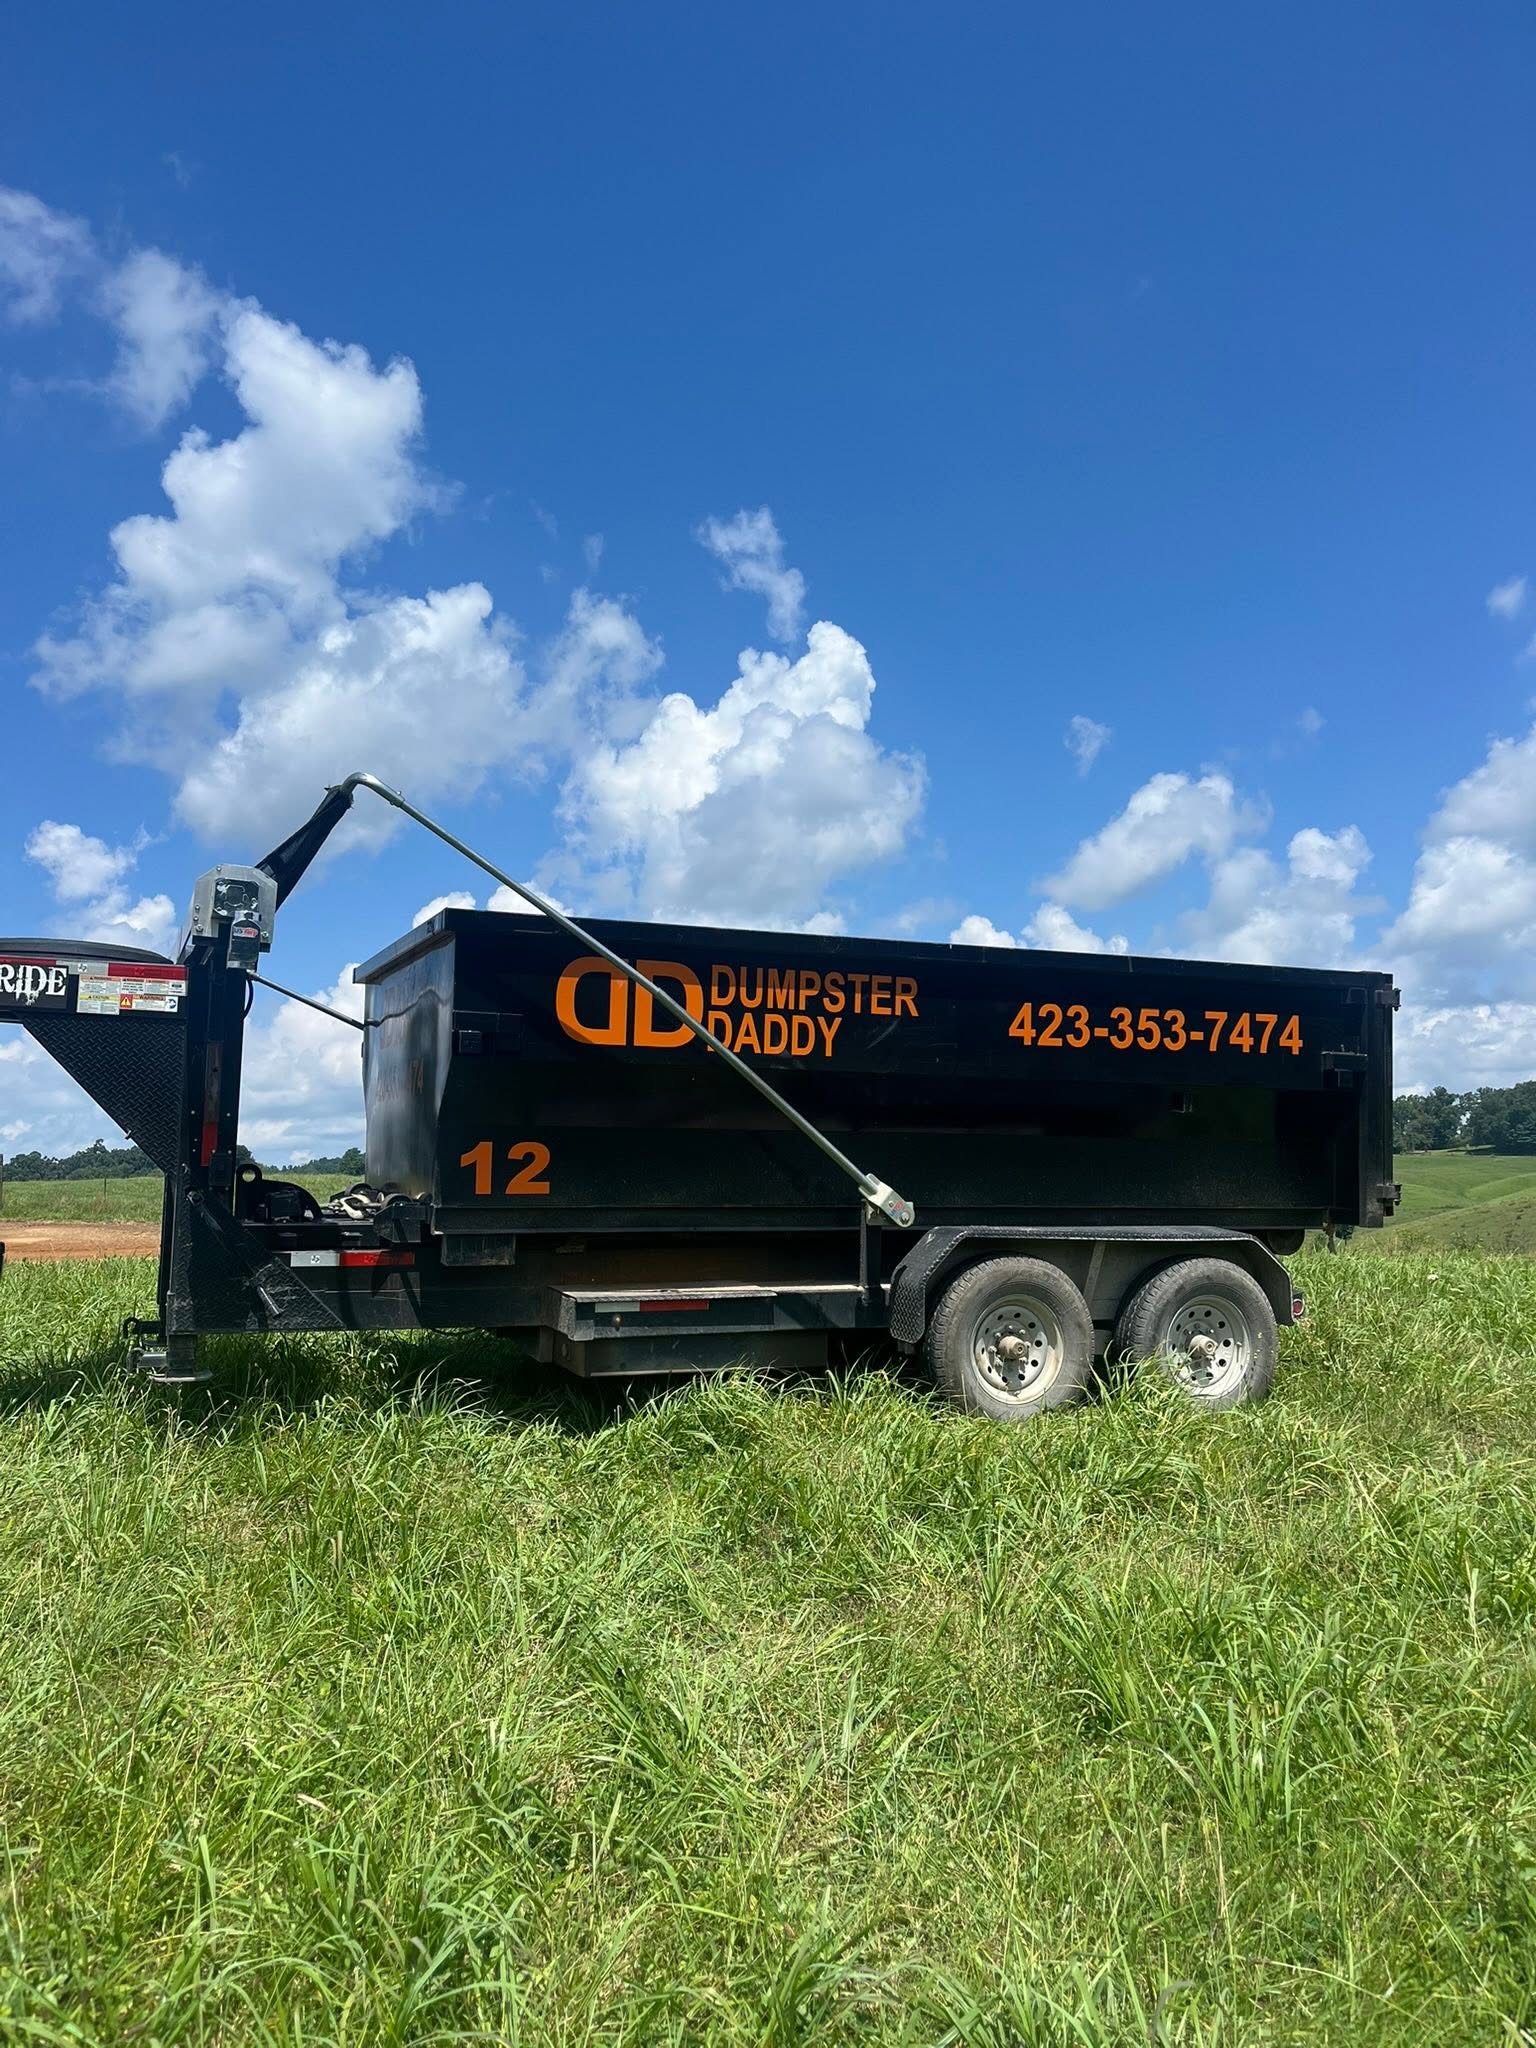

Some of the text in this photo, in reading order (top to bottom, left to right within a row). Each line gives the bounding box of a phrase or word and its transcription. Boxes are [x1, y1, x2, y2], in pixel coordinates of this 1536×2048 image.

[711, 964, 919, 1017] DUMPSTER
[706, 1010, 842, 1057] DADDY
[1008, 1002, 1303, 1055] 423-353-7474
[460, 1141, 551, 1195] 12
